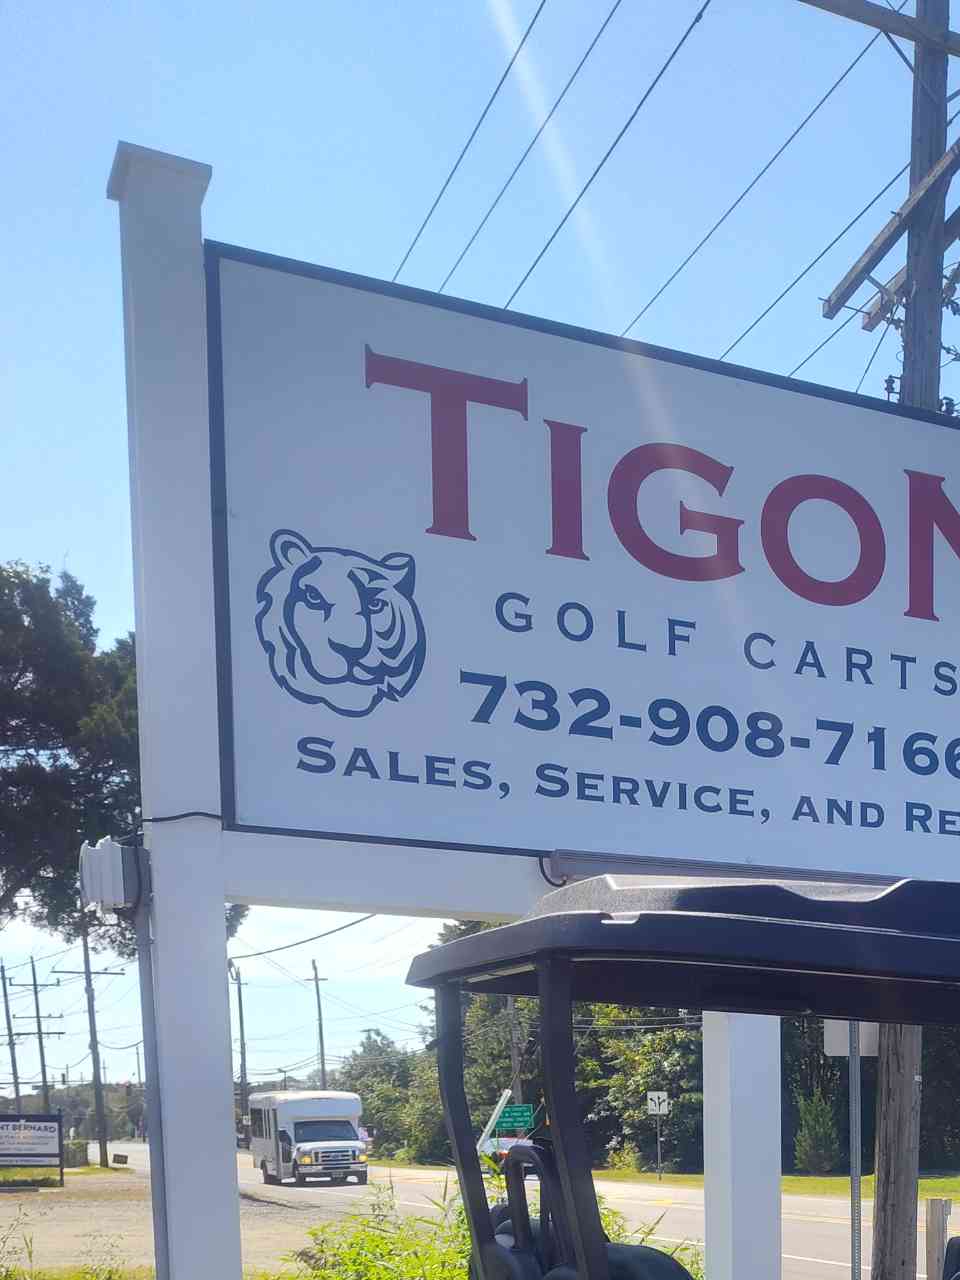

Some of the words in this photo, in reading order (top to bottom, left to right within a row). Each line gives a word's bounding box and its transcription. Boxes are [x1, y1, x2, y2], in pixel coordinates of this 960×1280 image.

[494, 592, 697, 657] GOLF
[743, 632, 959, 697] CARTS
[791, 795, 886, 829] AND
